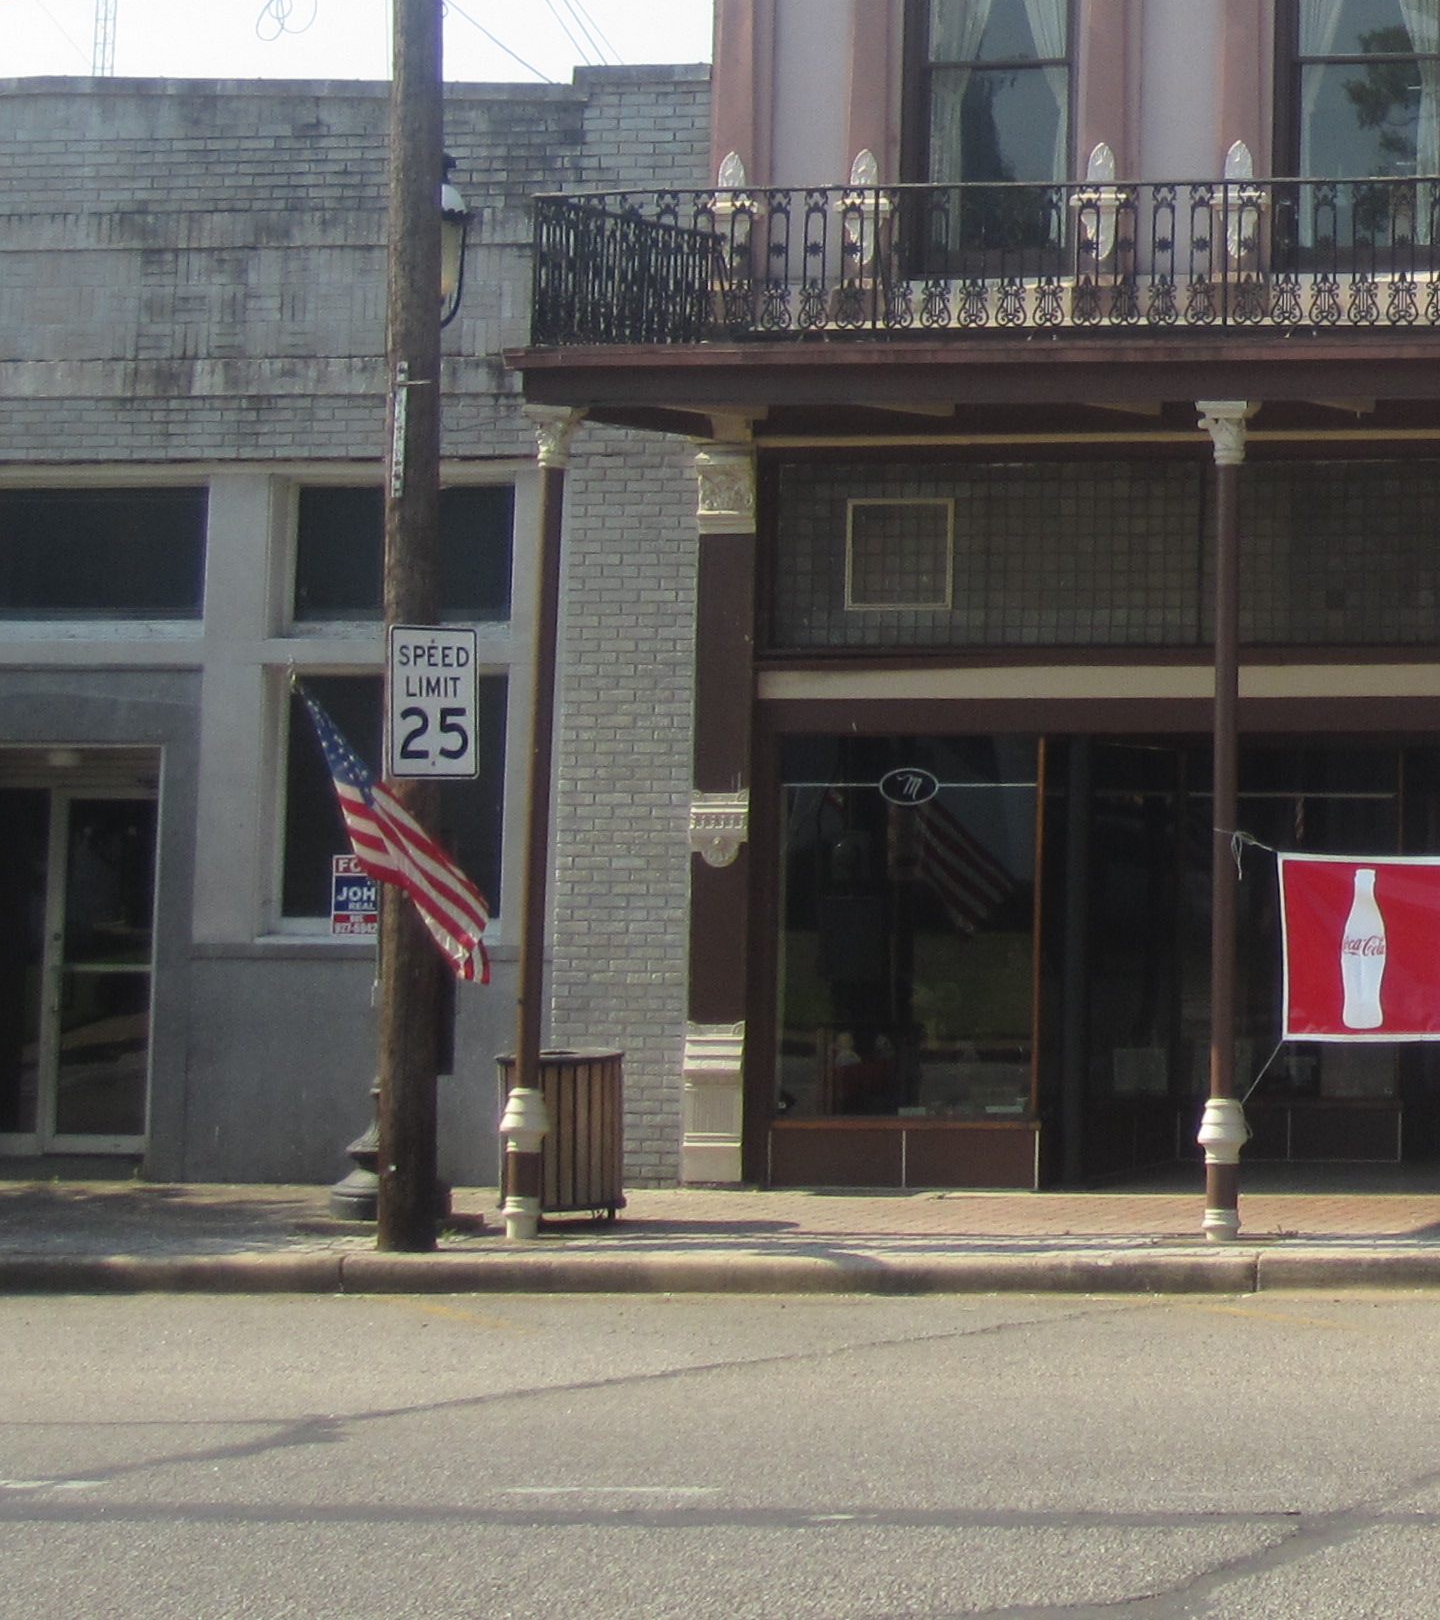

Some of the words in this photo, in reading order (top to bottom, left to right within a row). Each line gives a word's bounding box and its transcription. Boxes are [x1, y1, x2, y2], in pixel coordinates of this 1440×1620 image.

[399, 645, 469, 667] SPEED
[406, 676, 460, 698] LIMIT
[400, 706, 469, 759] 25
